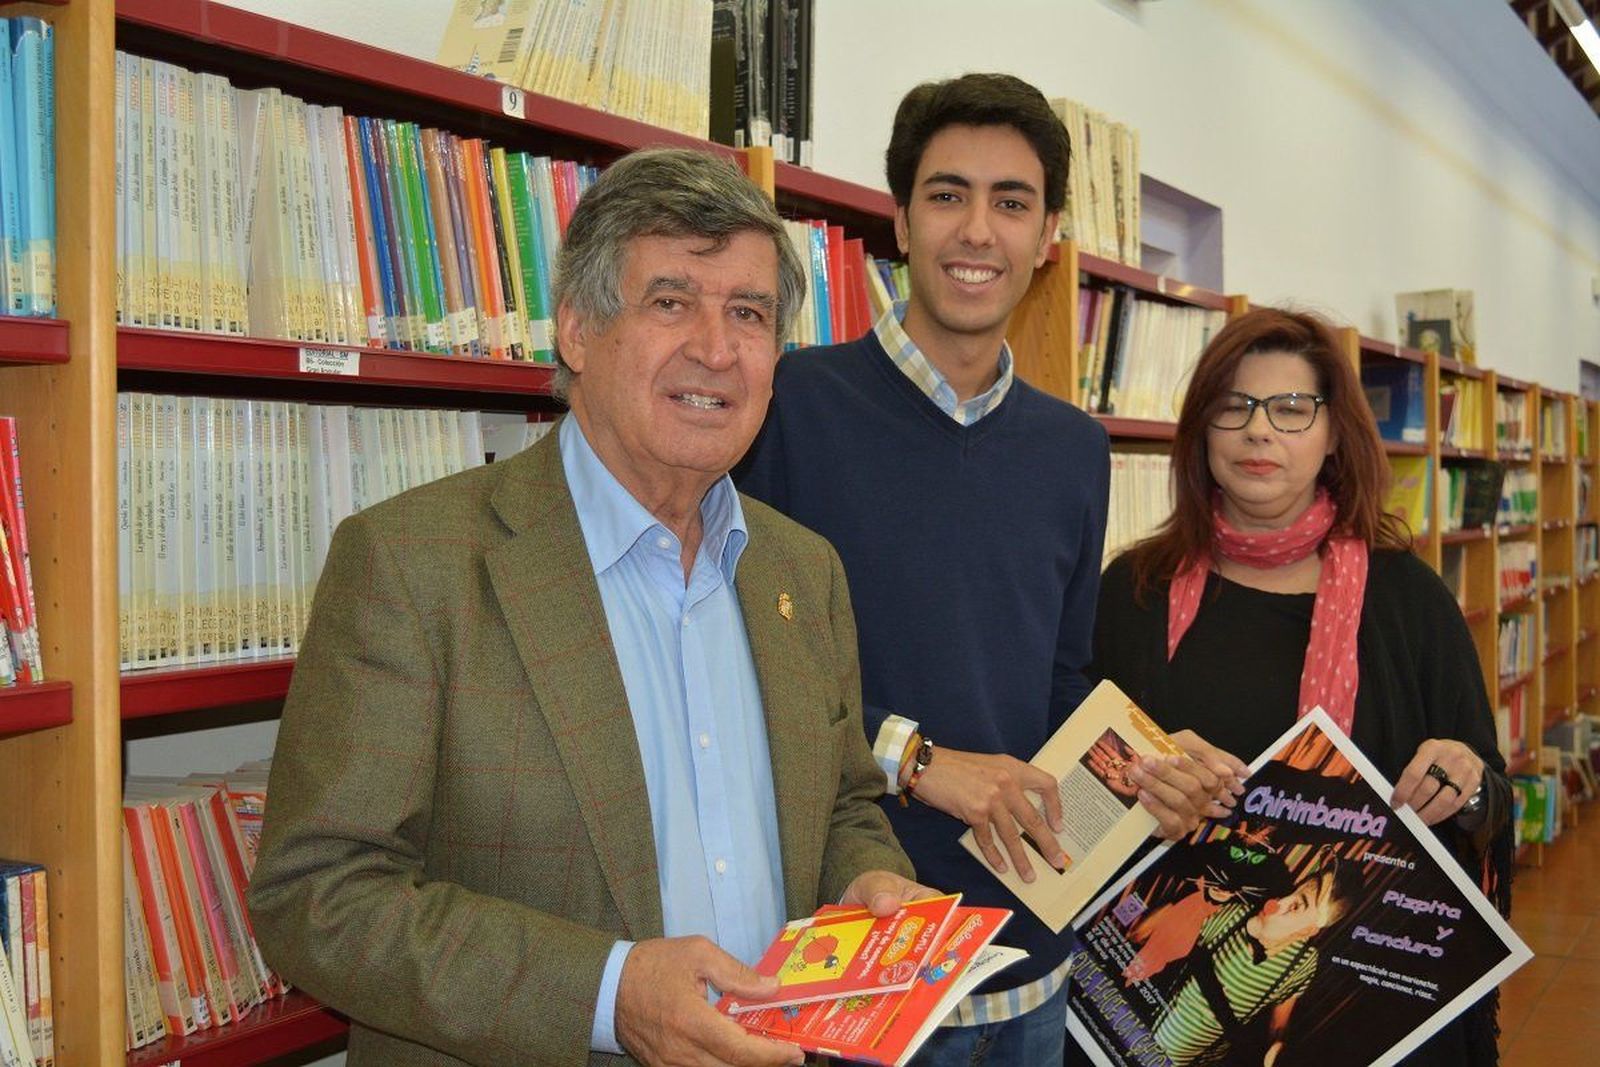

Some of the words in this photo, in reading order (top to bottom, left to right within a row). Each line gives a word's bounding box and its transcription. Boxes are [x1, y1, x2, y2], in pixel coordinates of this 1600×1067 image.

[509, 91, 517, 111] 9
[1244, 786, 1387, 838] Chirimbamba
[1363, 852, 1407, 870] presenta
[1407, 860, 1416, 871] a
[1352, 926, 1444, 959] Panduro
[1140, 987, 1157, 1005] 2017
